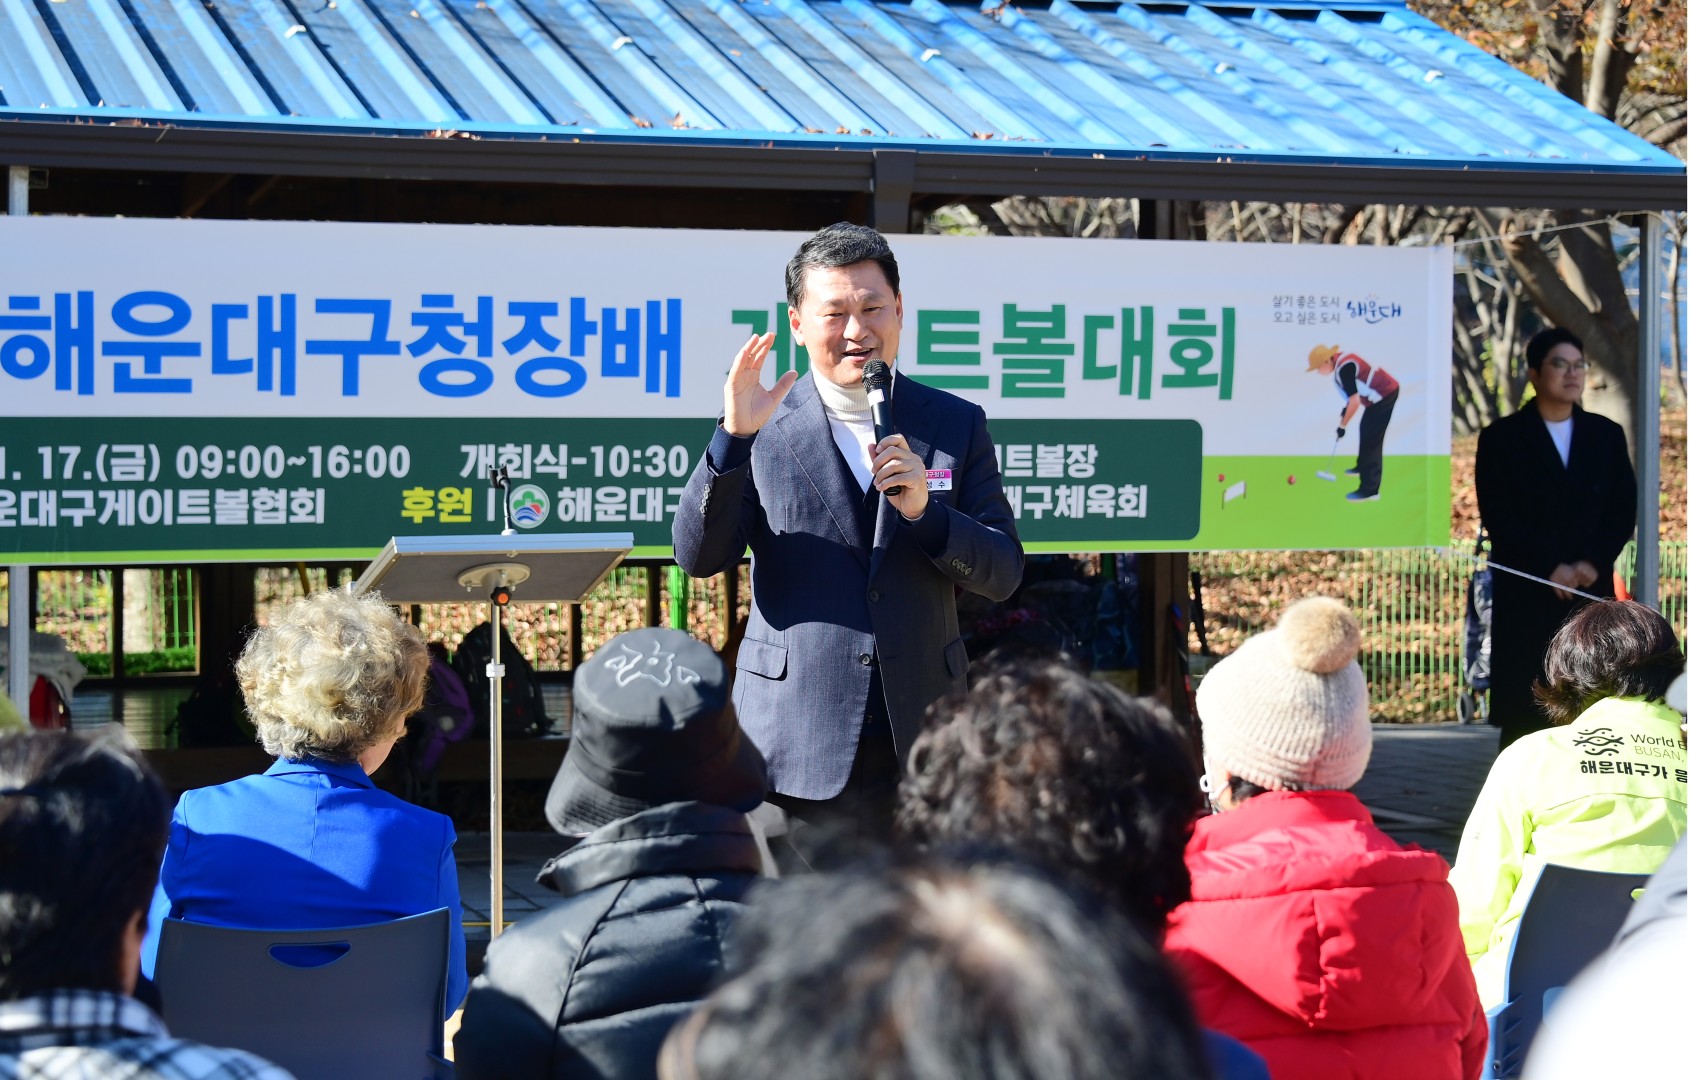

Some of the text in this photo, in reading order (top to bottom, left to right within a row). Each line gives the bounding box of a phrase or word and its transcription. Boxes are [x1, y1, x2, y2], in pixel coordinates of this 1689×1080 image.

[1273, 295, 1340, 308] 살기 좋은 도시
[1273, 312, 1294, 323] 오고
[1320, 312, 1340, 325] 도시
[1346, 300, 1402, 324] 해운대
[0, 290, 1236, 401] 해운대구청장배 게트볼대회
[38, 444, 161, 482] 17.(금)
[176, 445, 411, 479] 09:00~16:00
[459, 443, 689, 480] 개회식-10:30
[401, 487, 472, 523] 후원
[1630, 733, 1675, 748] World
[1634, 745, 1684, 763] BUSAN,
[1580, 760, 1668, 780] 해운대구가
